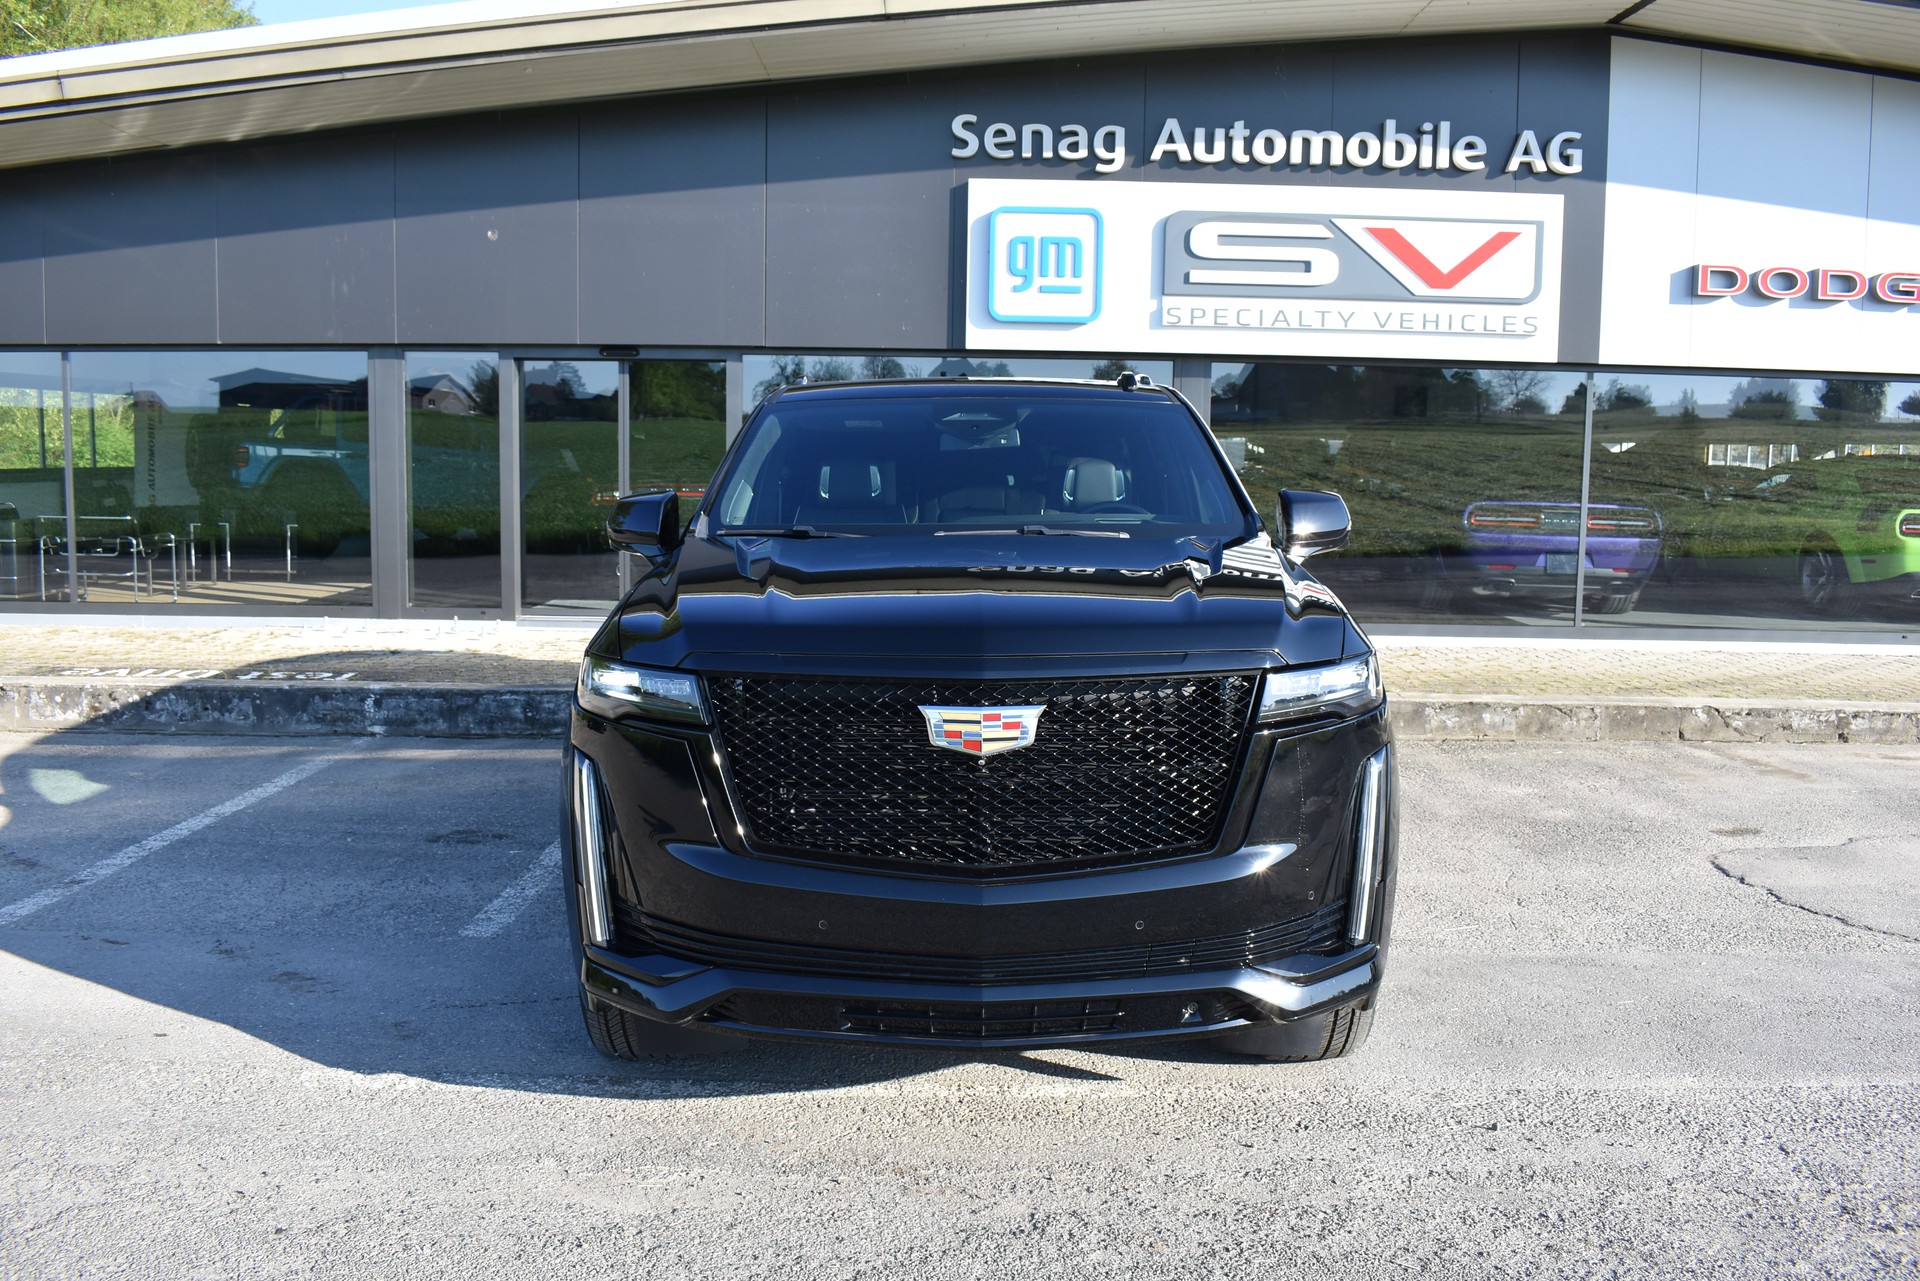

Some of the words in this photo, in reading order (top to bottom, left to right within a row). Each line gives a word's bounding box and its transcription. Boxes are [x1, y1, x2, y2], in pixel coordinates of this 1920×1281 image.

[951, 114, 1125, 173] Senag
[1150, 118, 1488, 172] Automobile
[1505, 130, 1583, 175] AG
[1008, 234, 1083, 294] gm
[1187, 220, 1523, 290] SV
[1166, 306, 1356, 329] SPECIALTY
[1373, 310, 1539, 334] VEHICLES
[147, 414, 157, 491] AUTOMOBILE
[60, 667, 223, 679] Drive
[236, 671, 359, 682] Test
